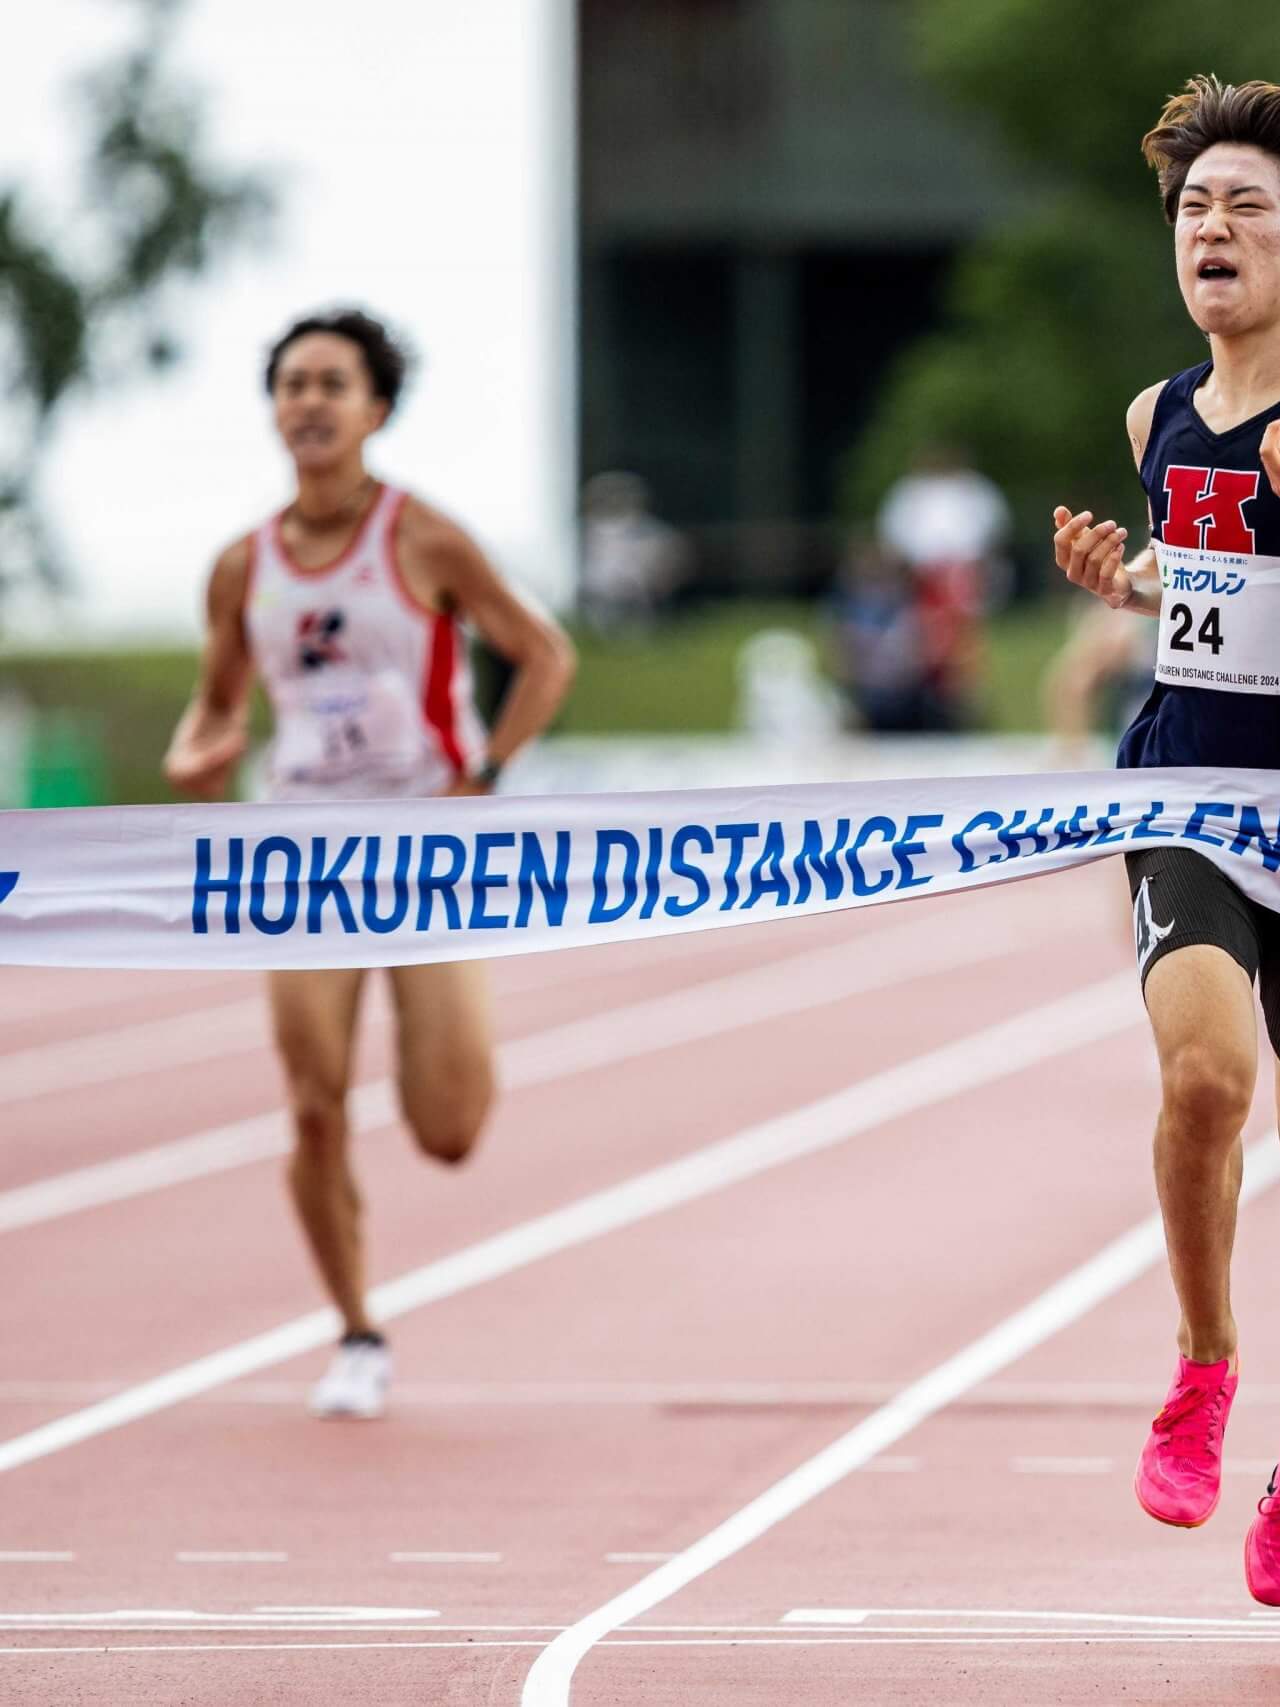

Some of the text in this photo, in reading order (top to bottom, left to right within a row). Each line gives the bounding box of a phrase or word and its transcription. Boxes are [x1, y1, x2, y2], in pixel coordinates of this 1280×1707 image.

[1160, 464, 1260, 555] K
[1172, 567, 1246, 595] ホクレン
[1170, 603, 1224, 655] 24
[1182, 667, 1215, 681] DISTANCE
[1216, 671, 1258, 685] CHALLENGE
[1260, 675, 1280, 687] 2024
[193, 831, 571, 935] HOKUREN
[587, 815, 943, 925] DISTANCE
